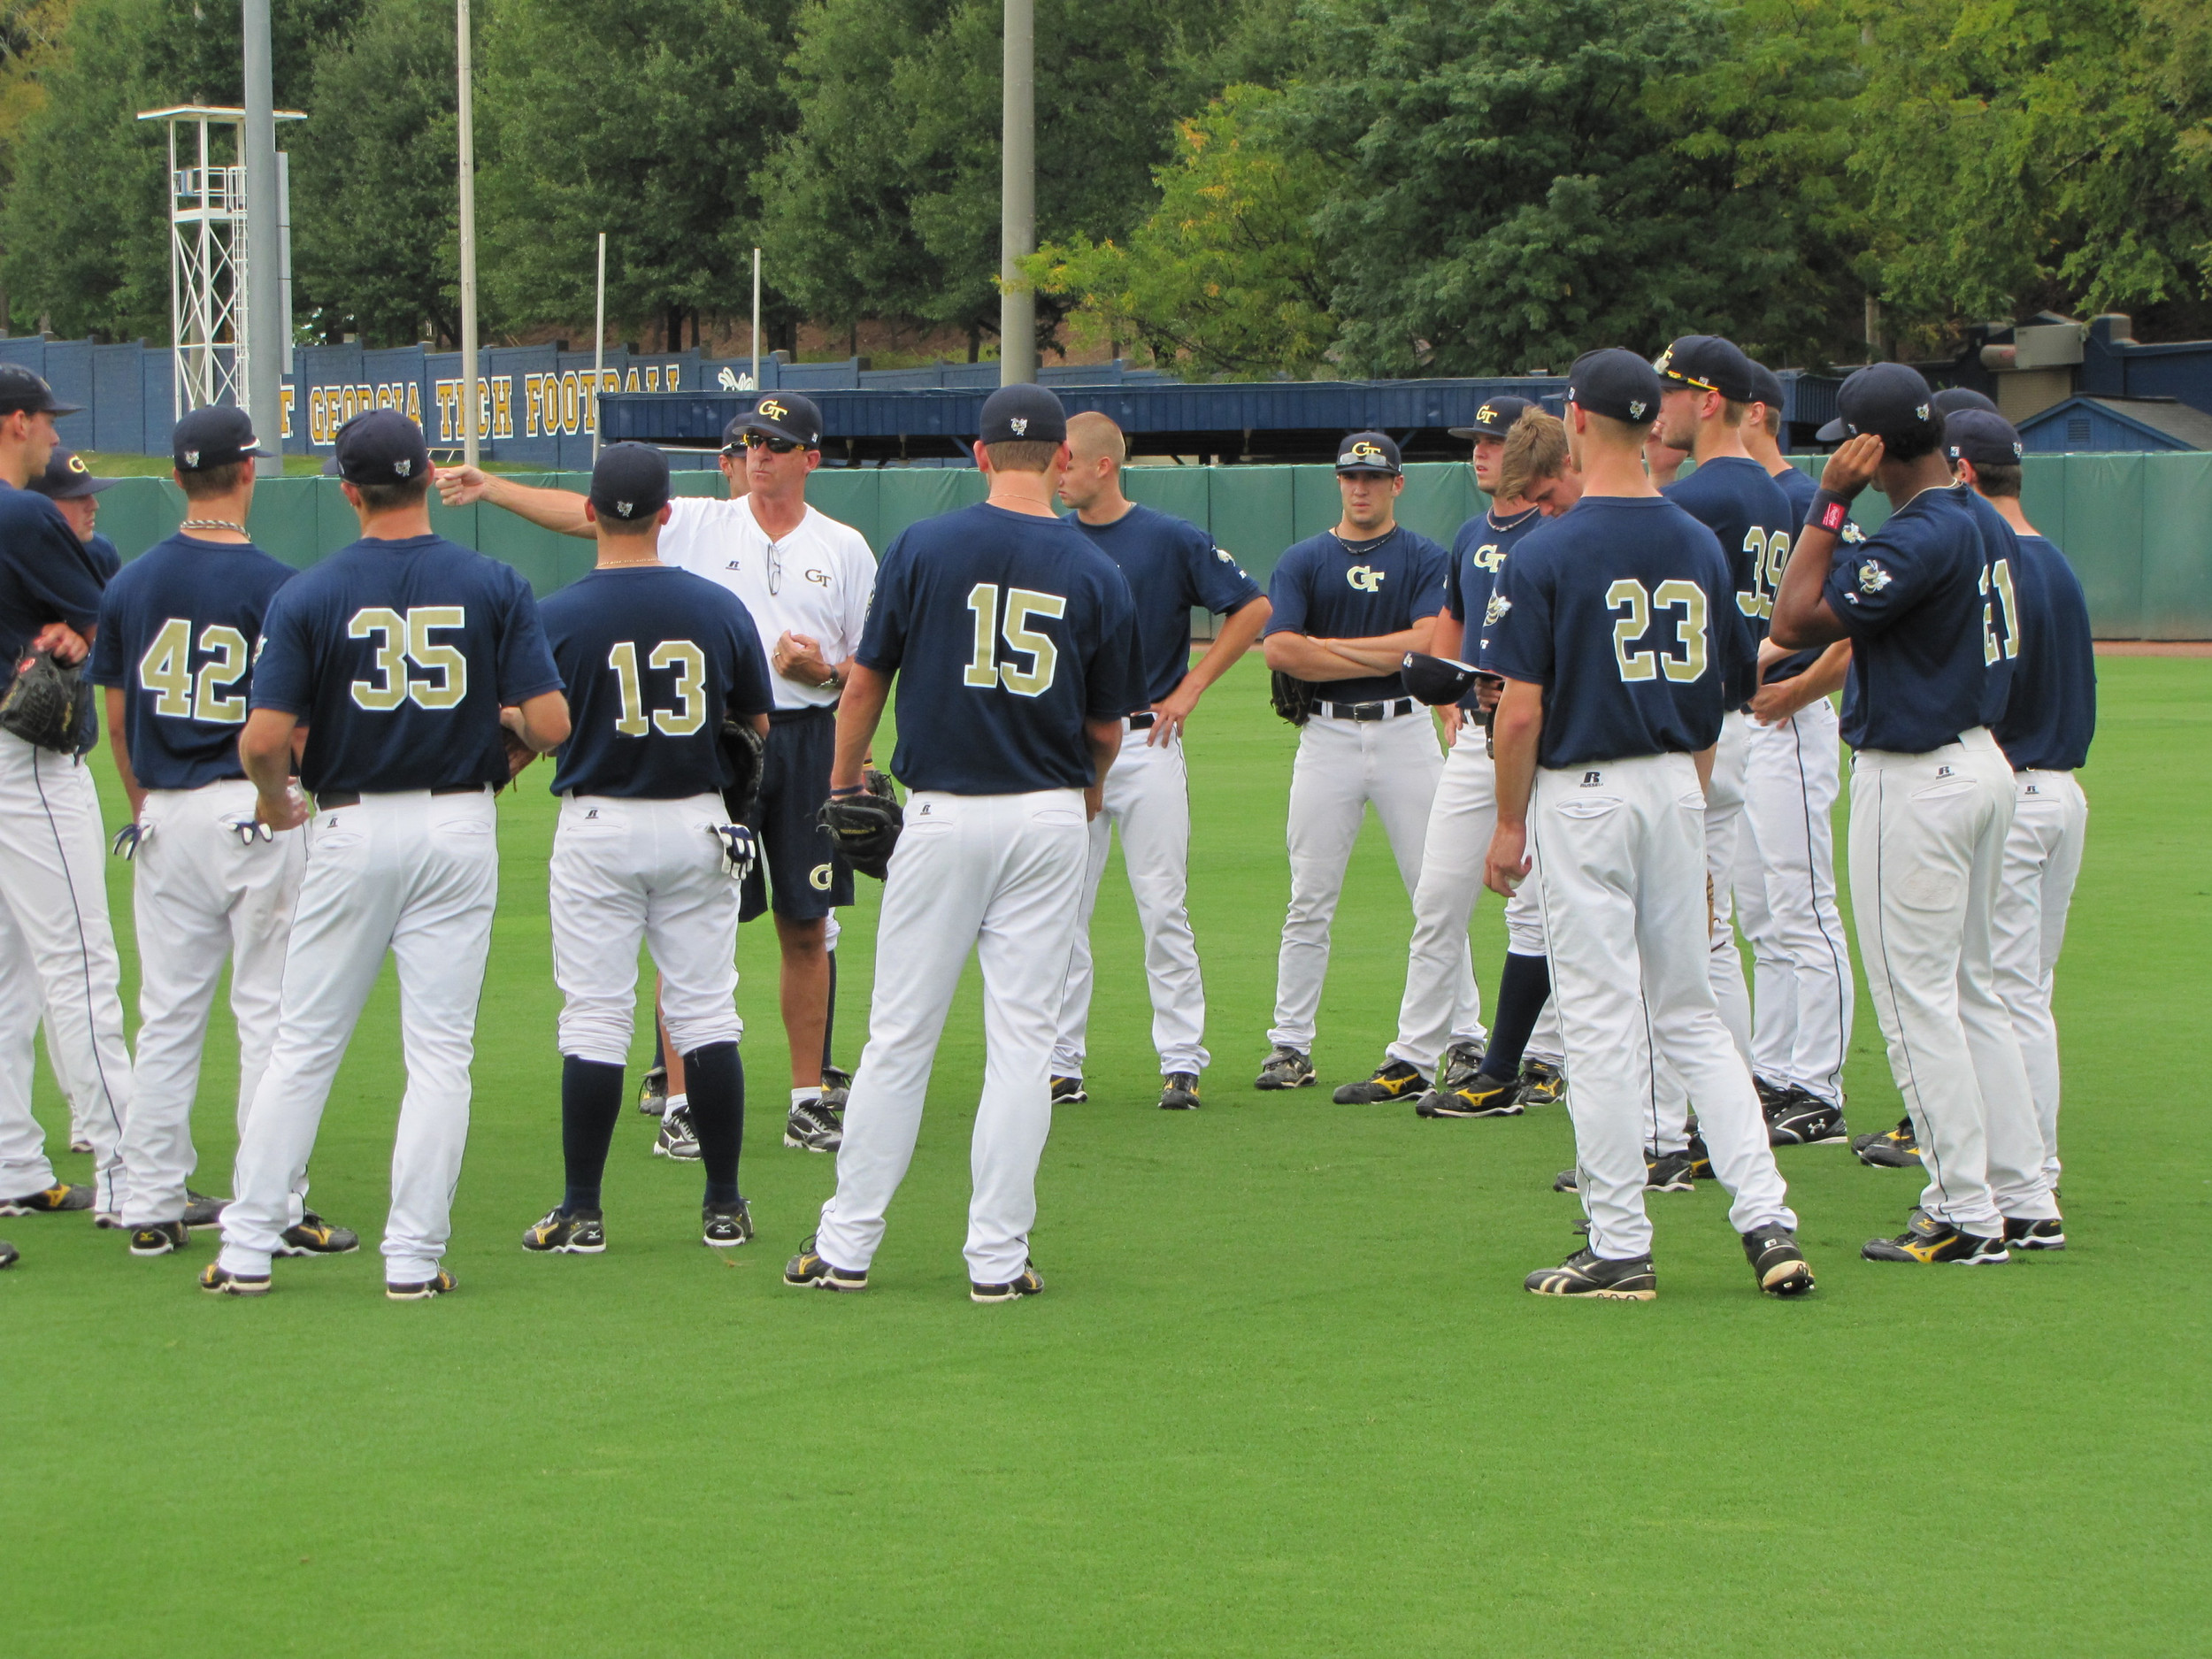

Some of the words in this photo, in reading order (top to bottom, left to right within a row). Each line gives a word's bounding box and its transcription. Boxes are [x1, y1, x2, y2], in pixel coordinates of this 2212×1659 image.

[525, 364, 679, 437] FOOT
[758, 400, 788, 421] GT
[1476, 404, 1499, 424] GT
[69, 455, 89, 473] G
[805, 569, 832, 588] GT
[1347, 565, 1385, 592] GT
[1473, 544, 1507, 572] GT
[1736, 526, 1790, 620] 39
[1605, 579, 1708, 683] 23
[1978, 559, 2019, 666] 21
[349, 606, 467, 710] 35
[964, 583, 1067, 697] 15
[140, 618, 248, 723] 42
[609, 640, 707, 736] 13
[1584, 772, 1600, 783] R
[810, 862, 833, 892] G
